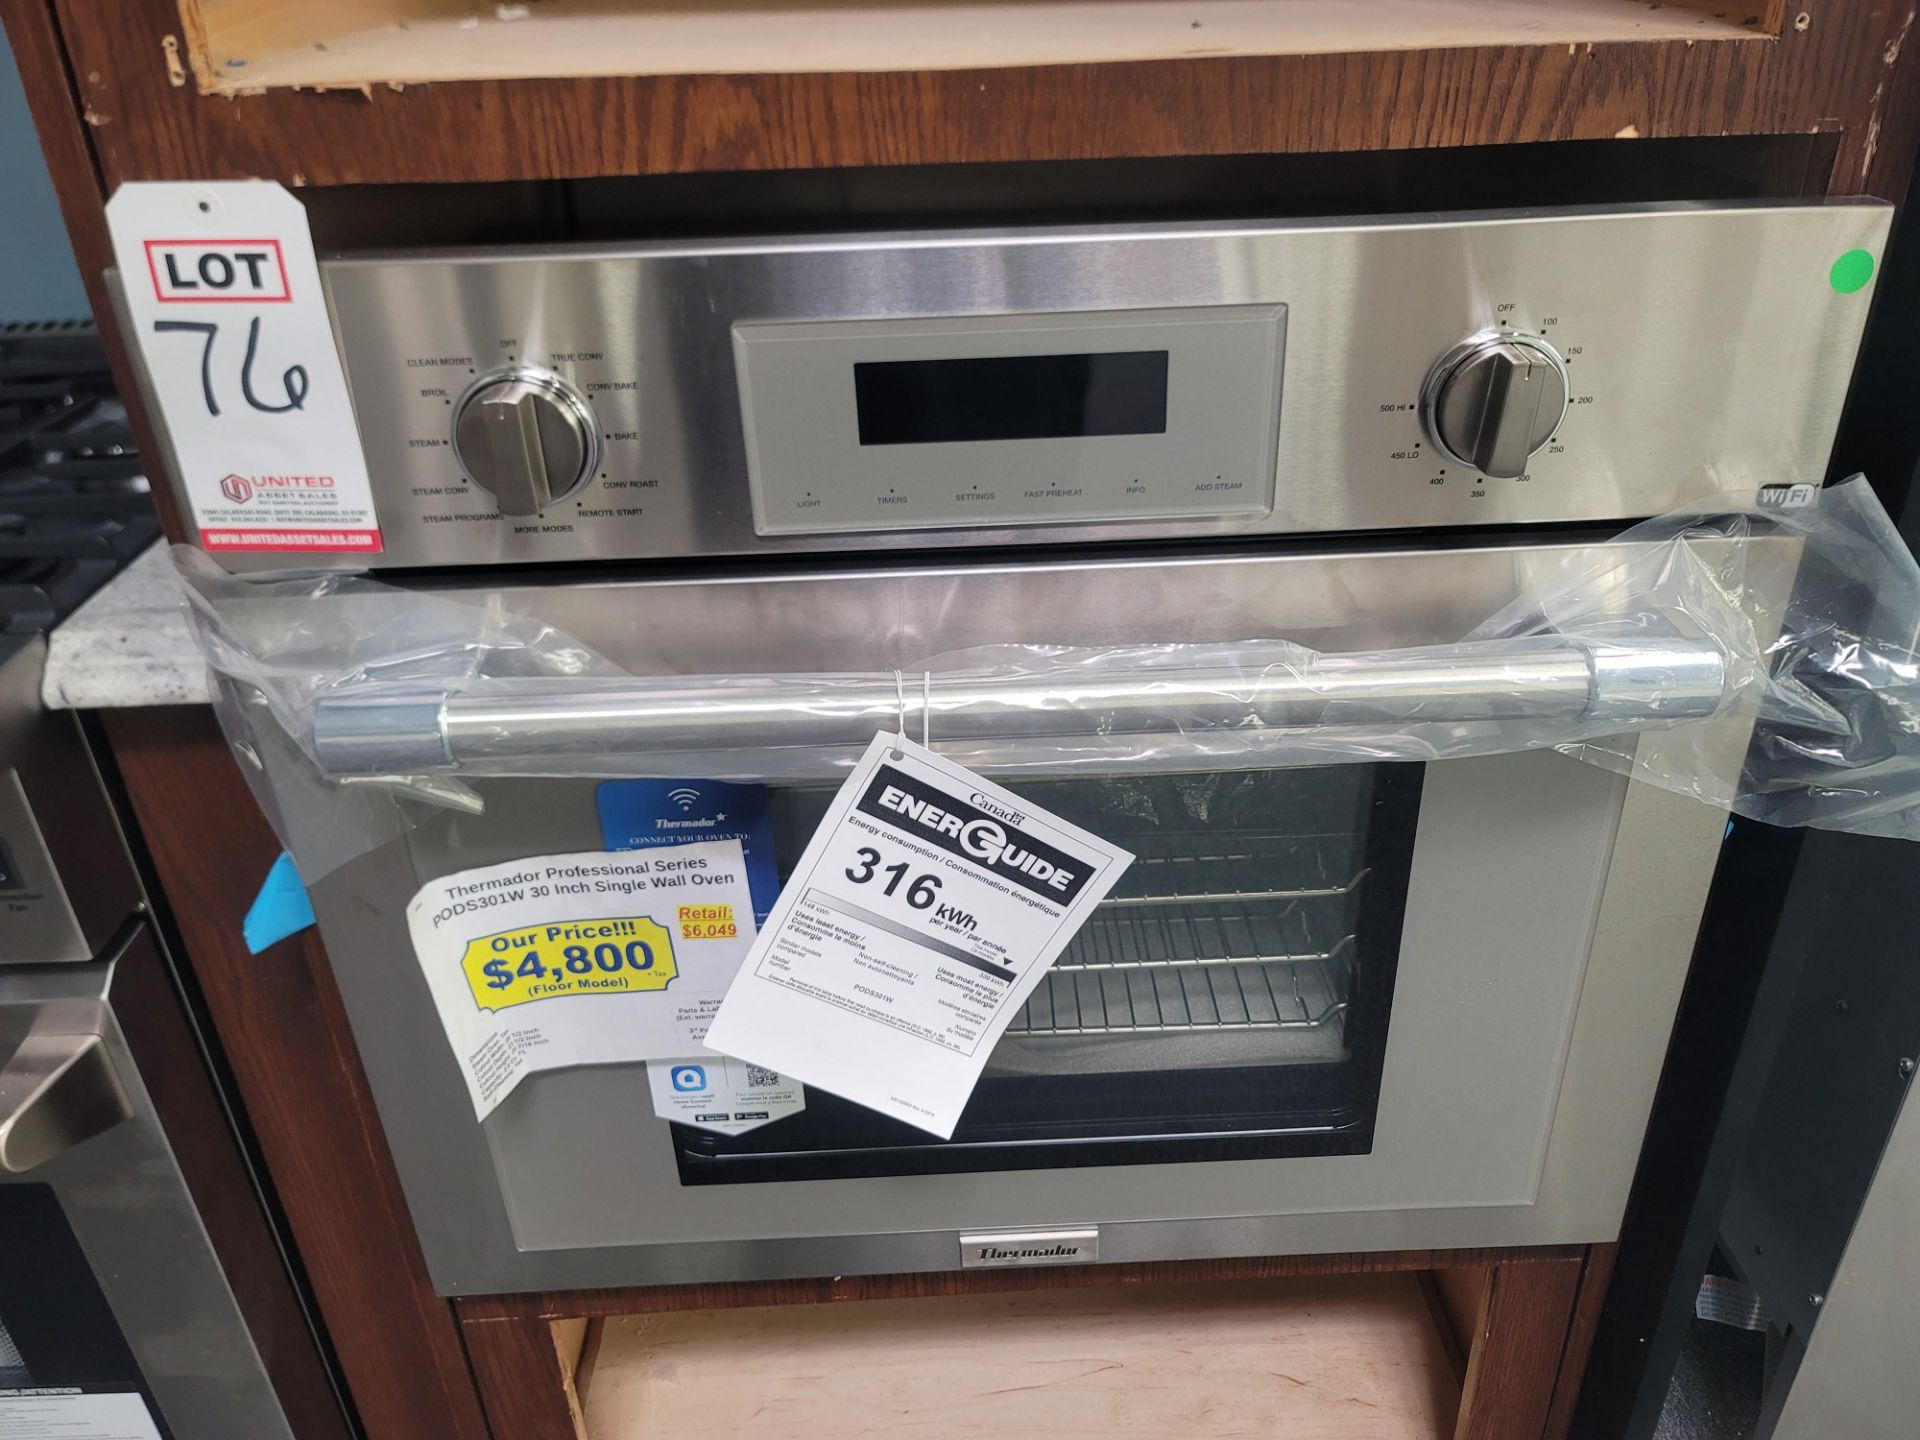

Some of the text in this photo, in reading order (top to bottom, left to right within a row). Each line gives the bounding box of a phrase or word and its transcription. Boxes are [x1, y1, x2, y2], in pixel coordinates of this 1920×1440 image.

[164, 253, 267, 290] LOT
[1497, 304, 1515, 312] OFF
[1543, 317, 1558, 326] 100
[500, 340, 517, 348] OFF
[1568, 347, 1582, 355] 150
[407, 357, 474, 367] CLEAN MODES
[552, 353, 603, 362] TRUE CONV
[154, 316, 308, 416] 76
[587, 382, 639, 391] CONV BAKE
[421, 389, 448, 398] BROIL
[1578, 396, 1593, 404] 200
[1380, 404, 1395, 412] 500
[615, 432, 639, 440] BAKE
[409, 439, 440, 448] STEAM
[1391, 451, 1419, 460] 450 LO
[1549, 446, 1564, 454] 250
[252, 476, 335, 487] UNITED
[1429, 478, 1444, 486] 400
[1515, 474, 1531, 482] 300
[629, 480, 659, 488] ROAST
[1195, 482, 1242, 491] ADD STEAM
[412, 486, 469, 496] STEAM CONV
[1024, 488, 1083, 499] FAST PREHEAT
[1126, 486, 1145, 494] INFO
[1470, 490, 1485, 498] 350
[877, 496, 908, 504] TIMERS
[955, 492, 995, 501] SETTINGS
[797, 500, 821, 508] LIGHT
[578, 508, 643, 518] REMOTE START
[422, 515, 453, 523] STEAM
[514, 525, 574, 534] MORE MODES
[969, 791, 1024, 827] Canada
[655, 818, 717, 829] Thermador
[629, 836, 675, 845] CONNECT
[877, 783, 1076, 892] ENERGUIDE
[848, 815, 1061, 919] Energy consumption / Consommation énergétique
[446, 857, 707, 900] Thermador Professional Series
[845, 847, 943, 910] 316
[432, 873, 735, 929] PODS301W 30 Inch Single Wall Oven
[679, 906, 734, 920] Retail:
[816, 905, 830, 916] kWh
[935, 903, 978, 932] kWh
[795, 910, 815, 922] Uses
[815, 917, 835, 930] least
[835, 926, 861, 941] energy
[491, 921, 636, 952] Our Price!!!
[683, 924, 737, 939] $6,049
[787, 924, 823, 942] d'énergie
[791, 917, 866, 951] Consomme le moins
[928, 916, 944, 927] per
[944, 922, 963, 934] year
[967, 933, 982, 943] par
[982, 939, 1007, 955] année
[776, 944, 807, 959] compared
[779, 937, 823, 958] Similar models
[483, 940, 655, 990] $4,800
[770, 953, 791, 966] Model
[768, 960, 792, 972] number
[858, 952, 915, 979] Non-self-cleaning
[853, 957, 916, 986] Non autonettoyants
[528, 976, 629, 998] (Floor Model)
[937, 966, 956, 978] Uses
[956, 973, 975, 986] most
[974, 982, 1000, 998] energy
[853, 983, 895, 1004] PODS301W
[935, 974, 999, 1004] Consomme le plus
[962, 993, 996, 1010] d'énergie
[979, 1244, 1080, 1260] Thermador
